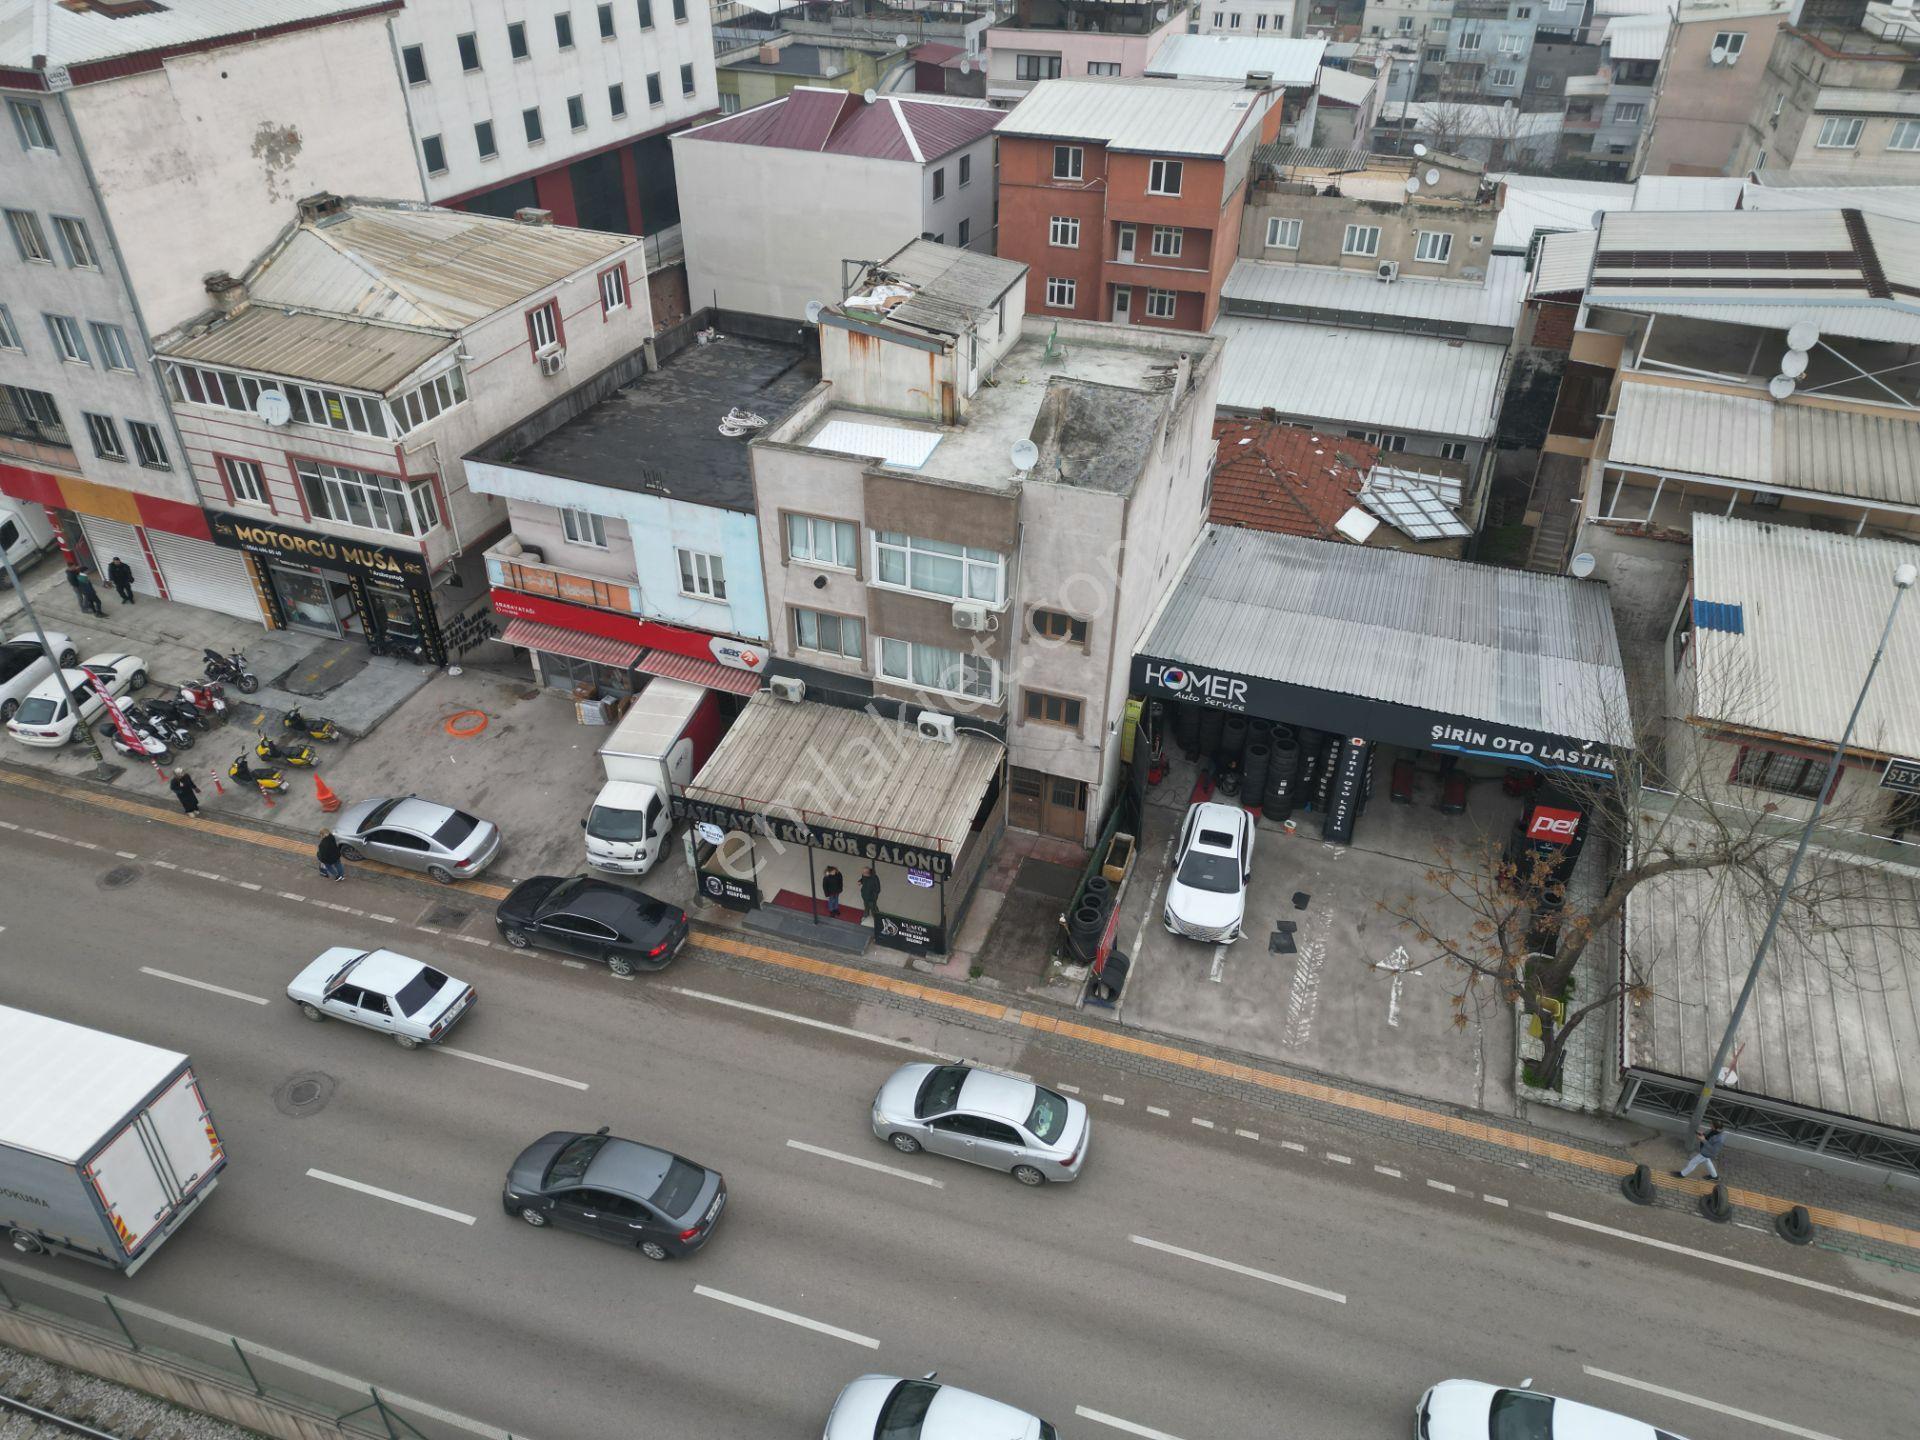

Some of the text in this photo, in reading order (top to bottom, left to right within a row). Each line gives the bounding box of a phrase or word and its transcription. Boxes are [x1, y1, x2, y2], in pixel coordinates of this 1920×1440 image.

[235, 524, 402, 573] MOTORCU MUSA
[1145, 663, 1246, 703] HOMER
[1174, 691, 1245, 711] Auto Service
[1431, 724, 1487, 746] ŞİRİN
[1492, 736, 1534, 755] OTO
[781, 824, 860, 856] KUAFÖR
[866, 843, 946, 875] SALONU
